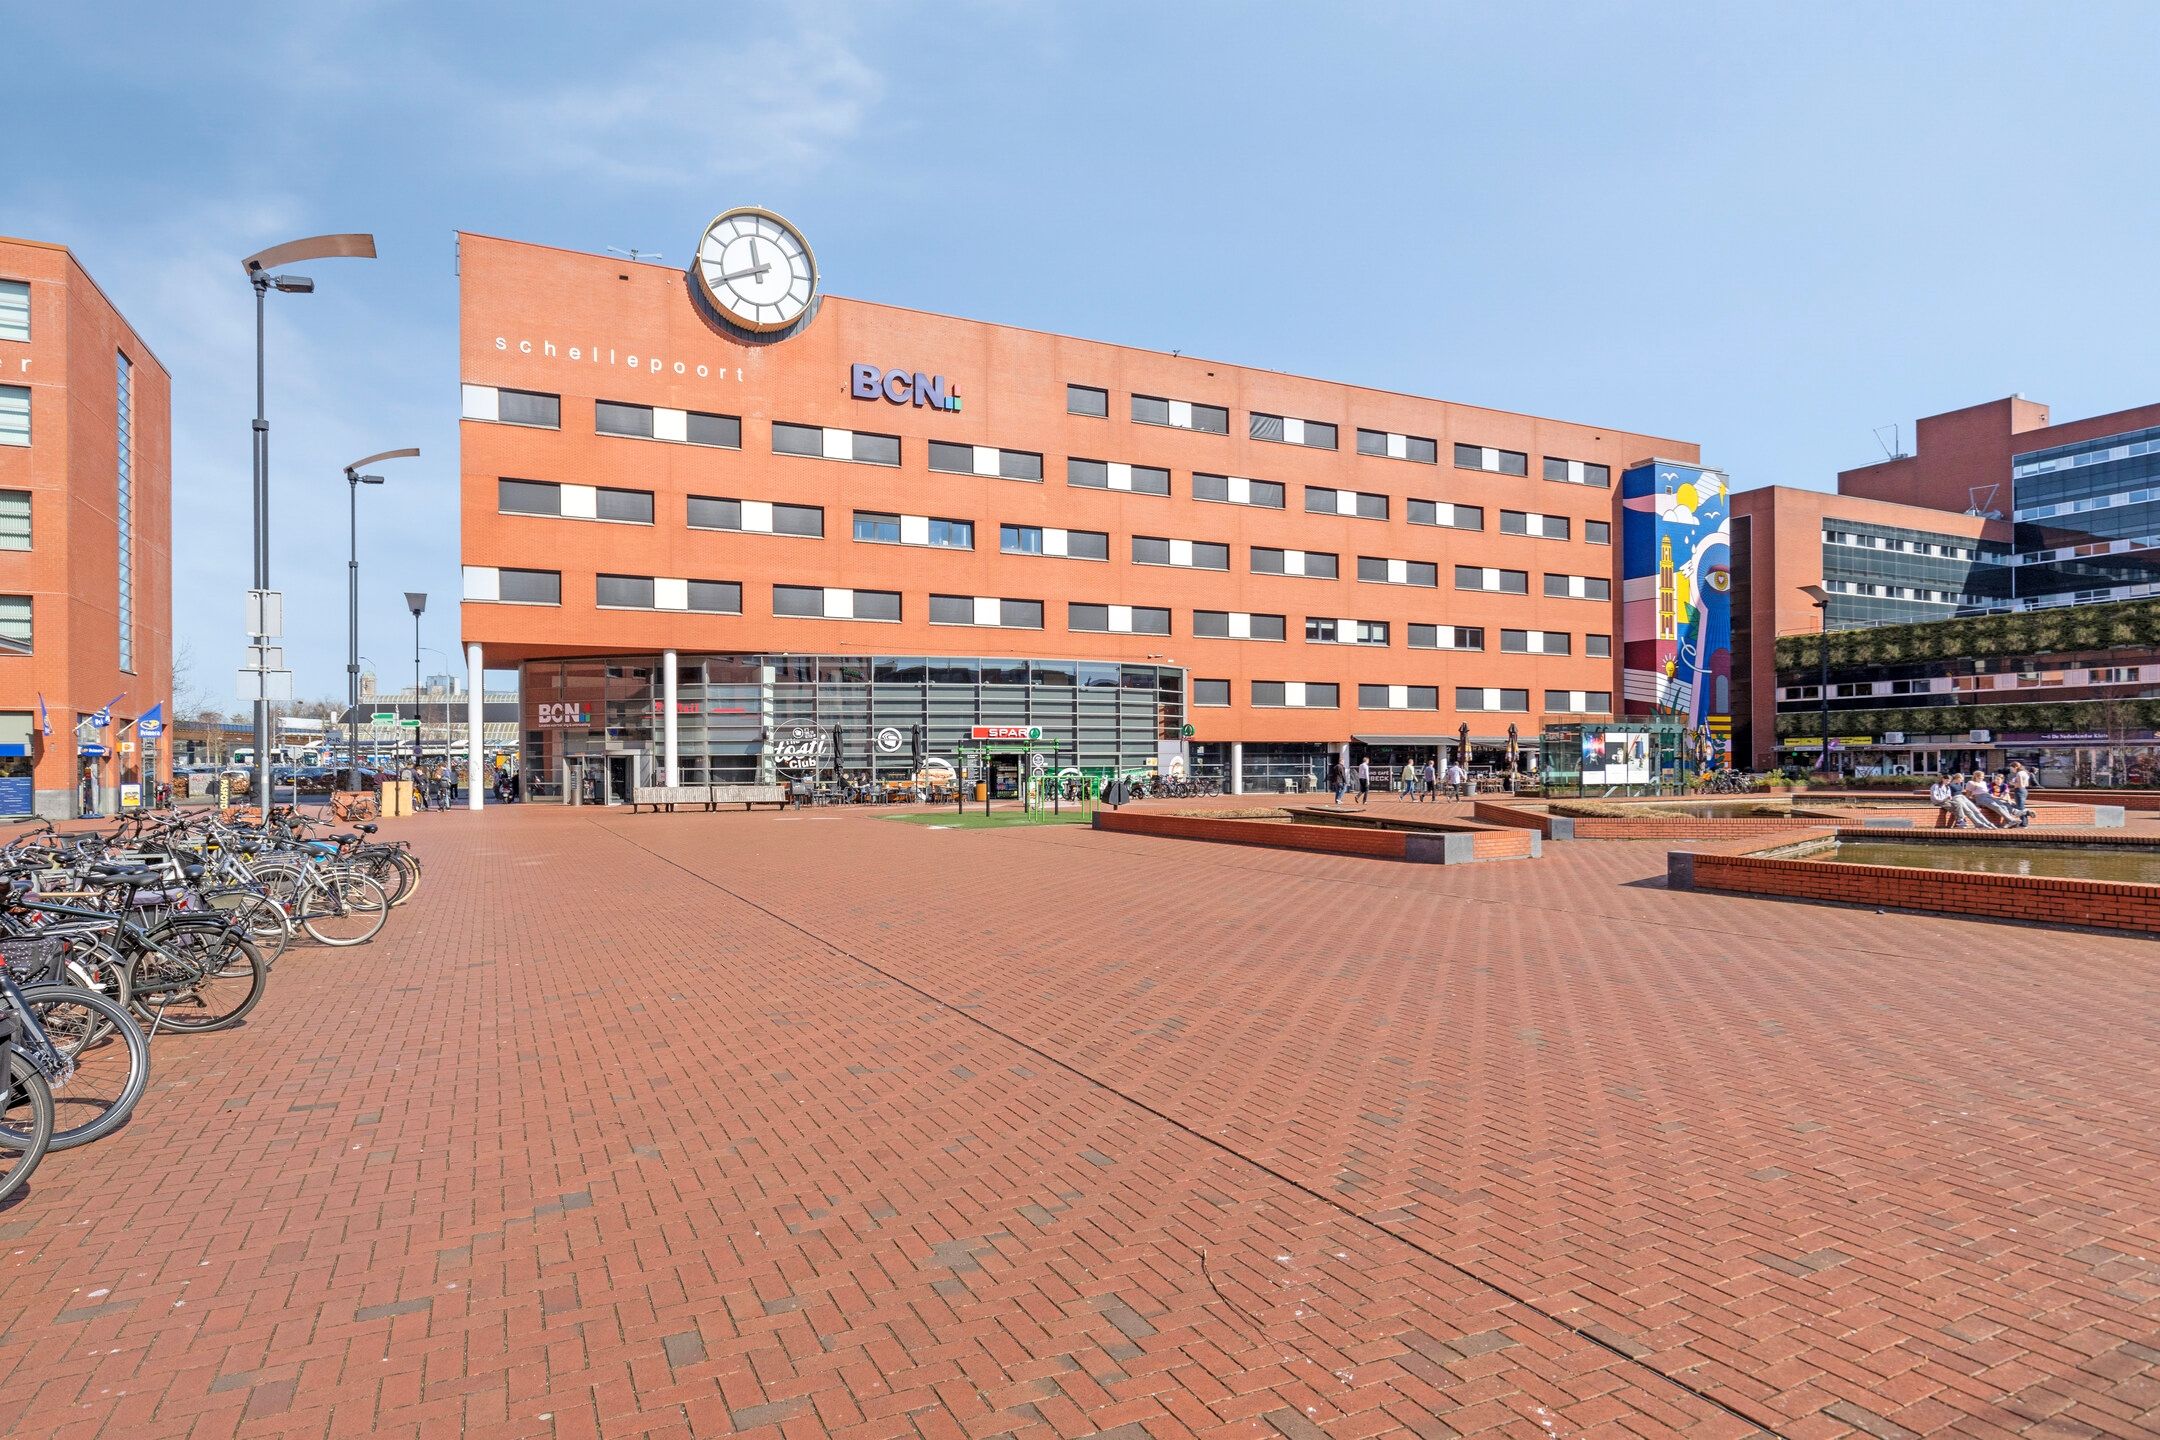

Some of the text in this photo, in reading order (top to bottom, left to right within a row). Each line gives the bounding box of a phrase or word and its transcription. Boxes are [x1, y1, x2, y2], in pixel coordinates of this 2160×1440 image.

[494, 334, 746, 383] schellepoort
[851, 363, 945, 409] BCN
[538, 703, 580, 723] BCN
[988, 728, 1028, 737] SPAR
[219, 779, 229, 810] PASFOTO
